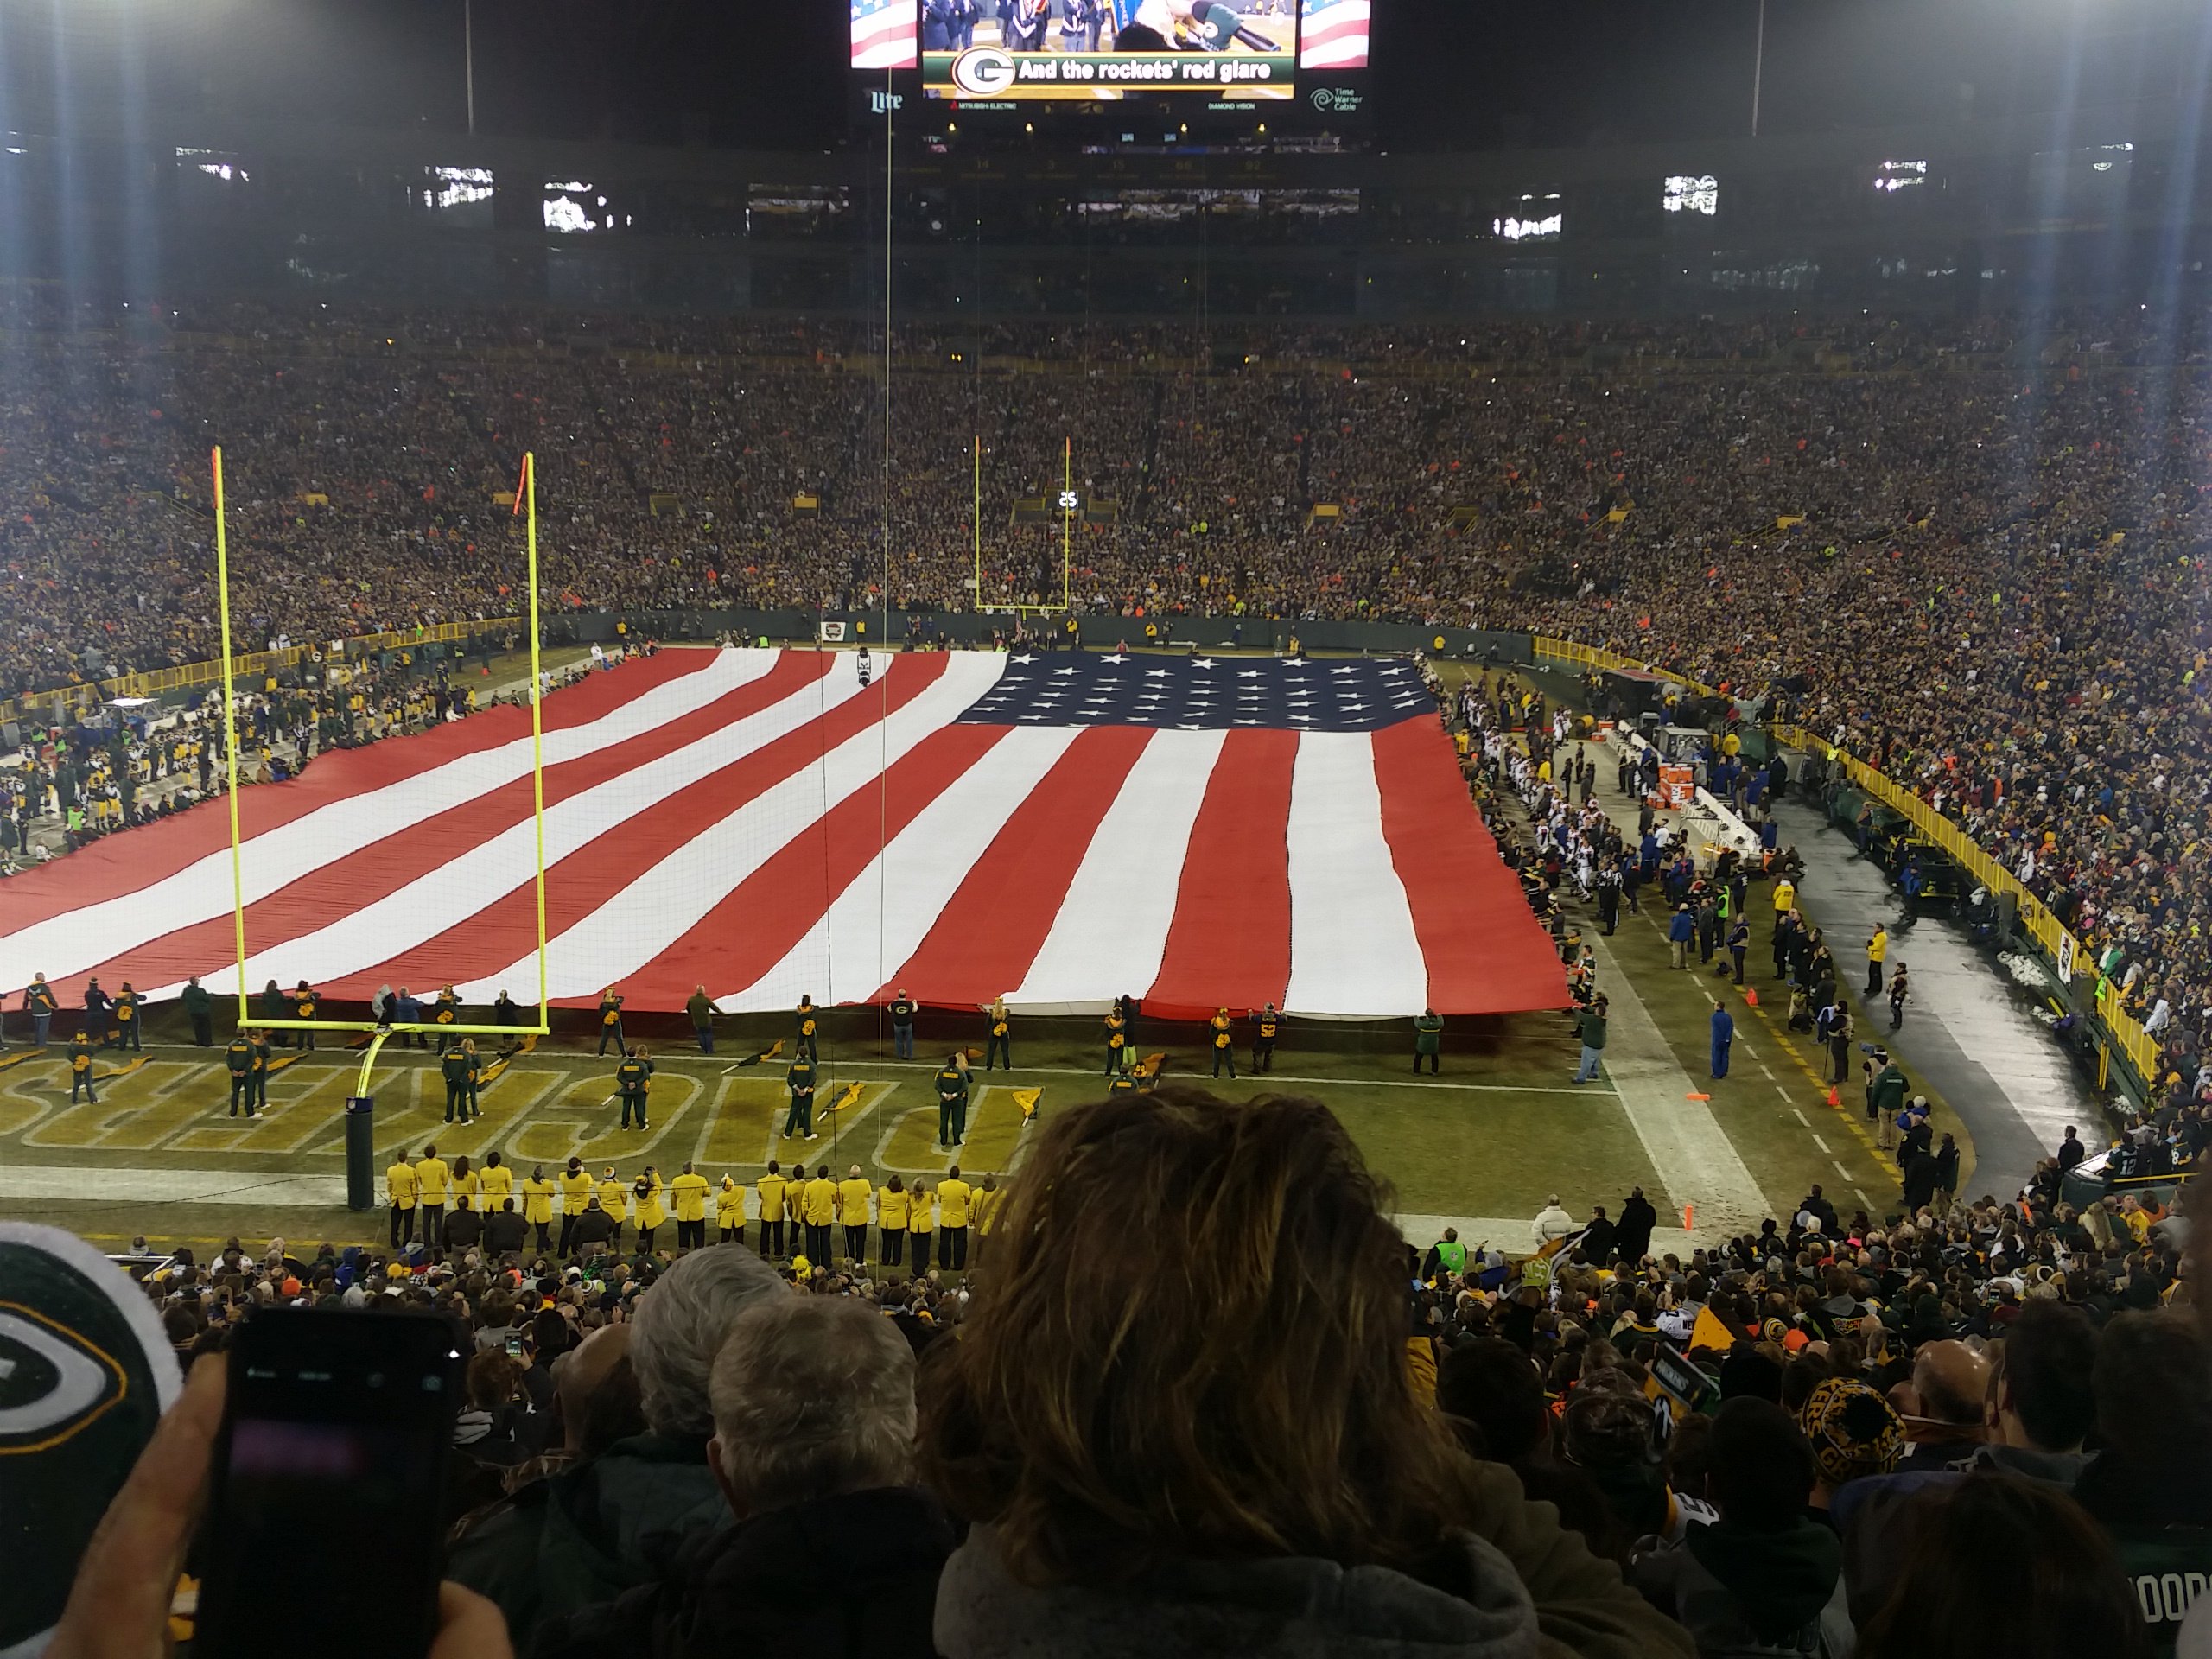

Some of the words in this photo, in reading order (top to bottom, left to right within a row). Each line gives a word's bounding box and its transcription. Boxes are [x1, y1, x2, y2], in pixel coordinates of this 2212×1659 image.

[1019, 60, 1057, 79] And
[1061, 60, 1094, 79] the
[1098, 60, 1179, 79] rockets'
[1182, 60, 1215, 79] red
[1219, 60, 1272, 83] glare
[871, 91, 904, 113] Lite
[2119, 1158, 2138, 1177] 12
